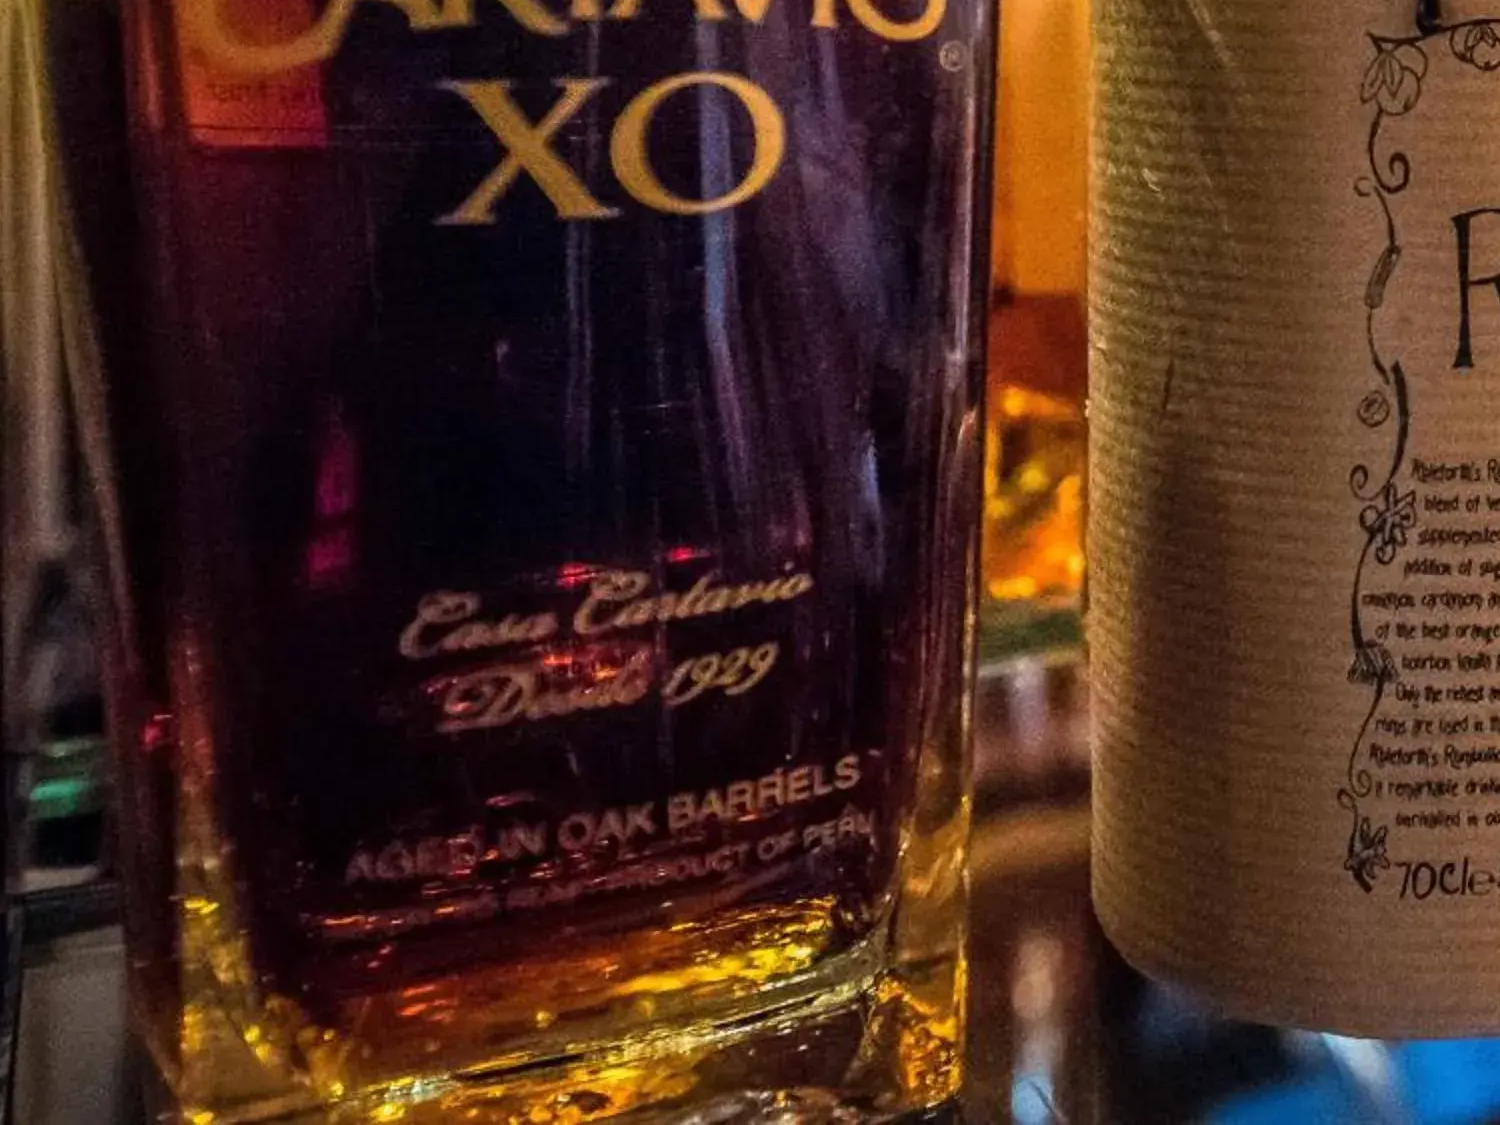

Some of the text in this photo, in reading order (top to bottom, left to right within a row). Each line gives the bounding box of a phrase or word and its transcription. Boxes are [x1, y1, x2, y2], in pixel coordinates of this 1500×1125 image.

[433, 73, 787, 226] XO
[1465, 495, 1480, 512] of
[1459, 558, 1473, 575] of
[661, 640, 780, 707] 1929
[557, 801, 657, 851] OAK
[667, 754, 862, 832] BARRELS
